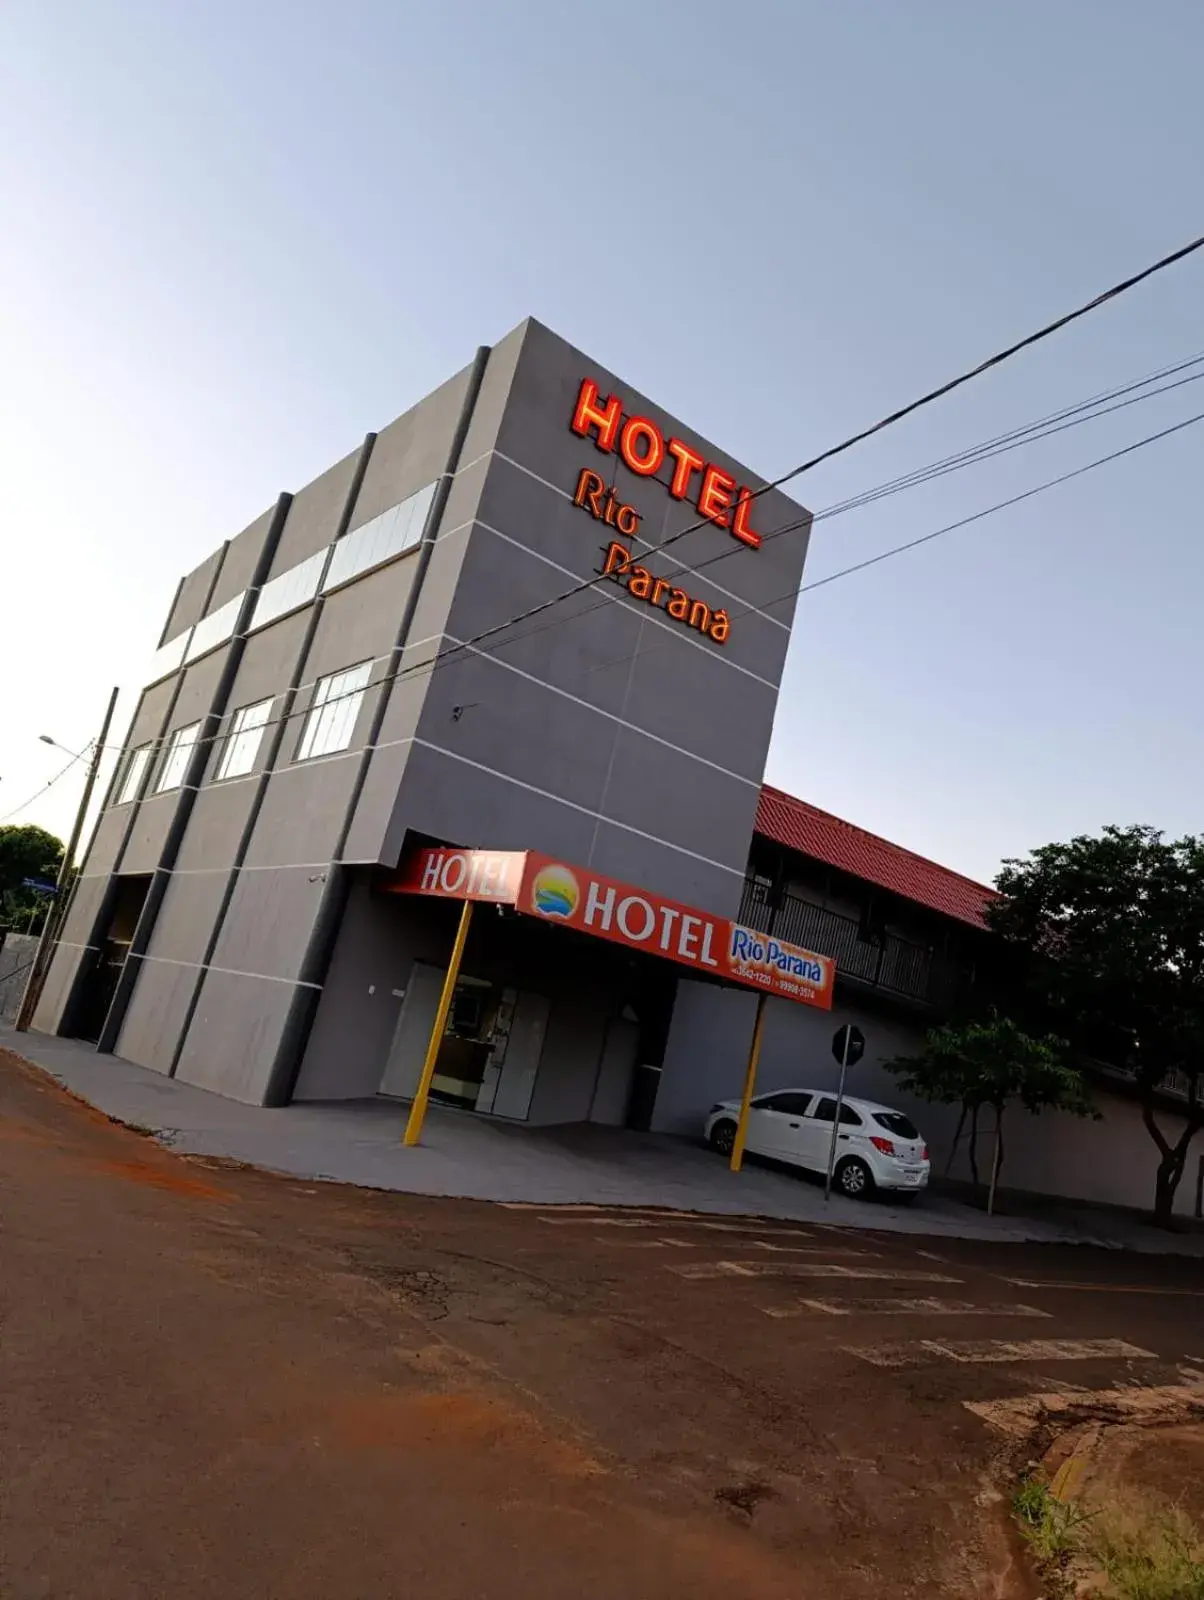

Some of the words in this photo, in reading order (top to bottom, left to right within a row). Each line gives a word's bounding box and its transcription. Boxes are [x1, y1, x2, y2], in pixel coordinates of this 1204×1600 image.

[570, 377, 762, 549] HOTEL
[573, 468, 638, 535] Rio
[421, 852, 512, 898] HOTEL
[583, 881, 718, 967] HOTEL
[732, 929, 763, 961] Rio
